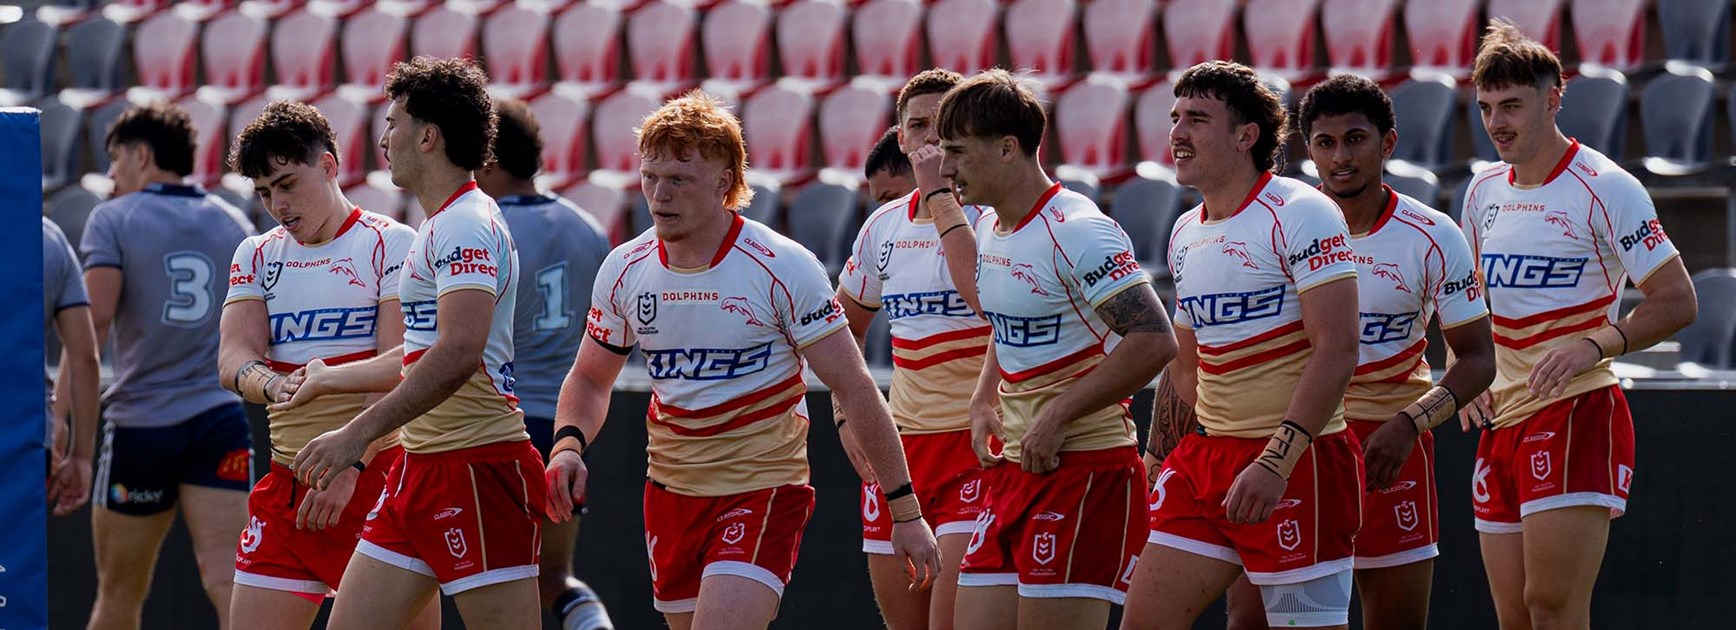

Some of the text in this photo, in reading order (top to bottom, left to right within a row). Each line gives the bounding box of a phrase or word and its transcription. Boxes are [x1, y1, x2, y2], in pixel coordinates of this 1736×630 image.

[1502, 204, 1545, 212] DOLPHINS
[286, 258, 331, 268] DOLPHINS
[163, 253, 213, 325] 3
[534, 263, 574, 330] 1
[663, 291, 719, 301] DOLPHINS
